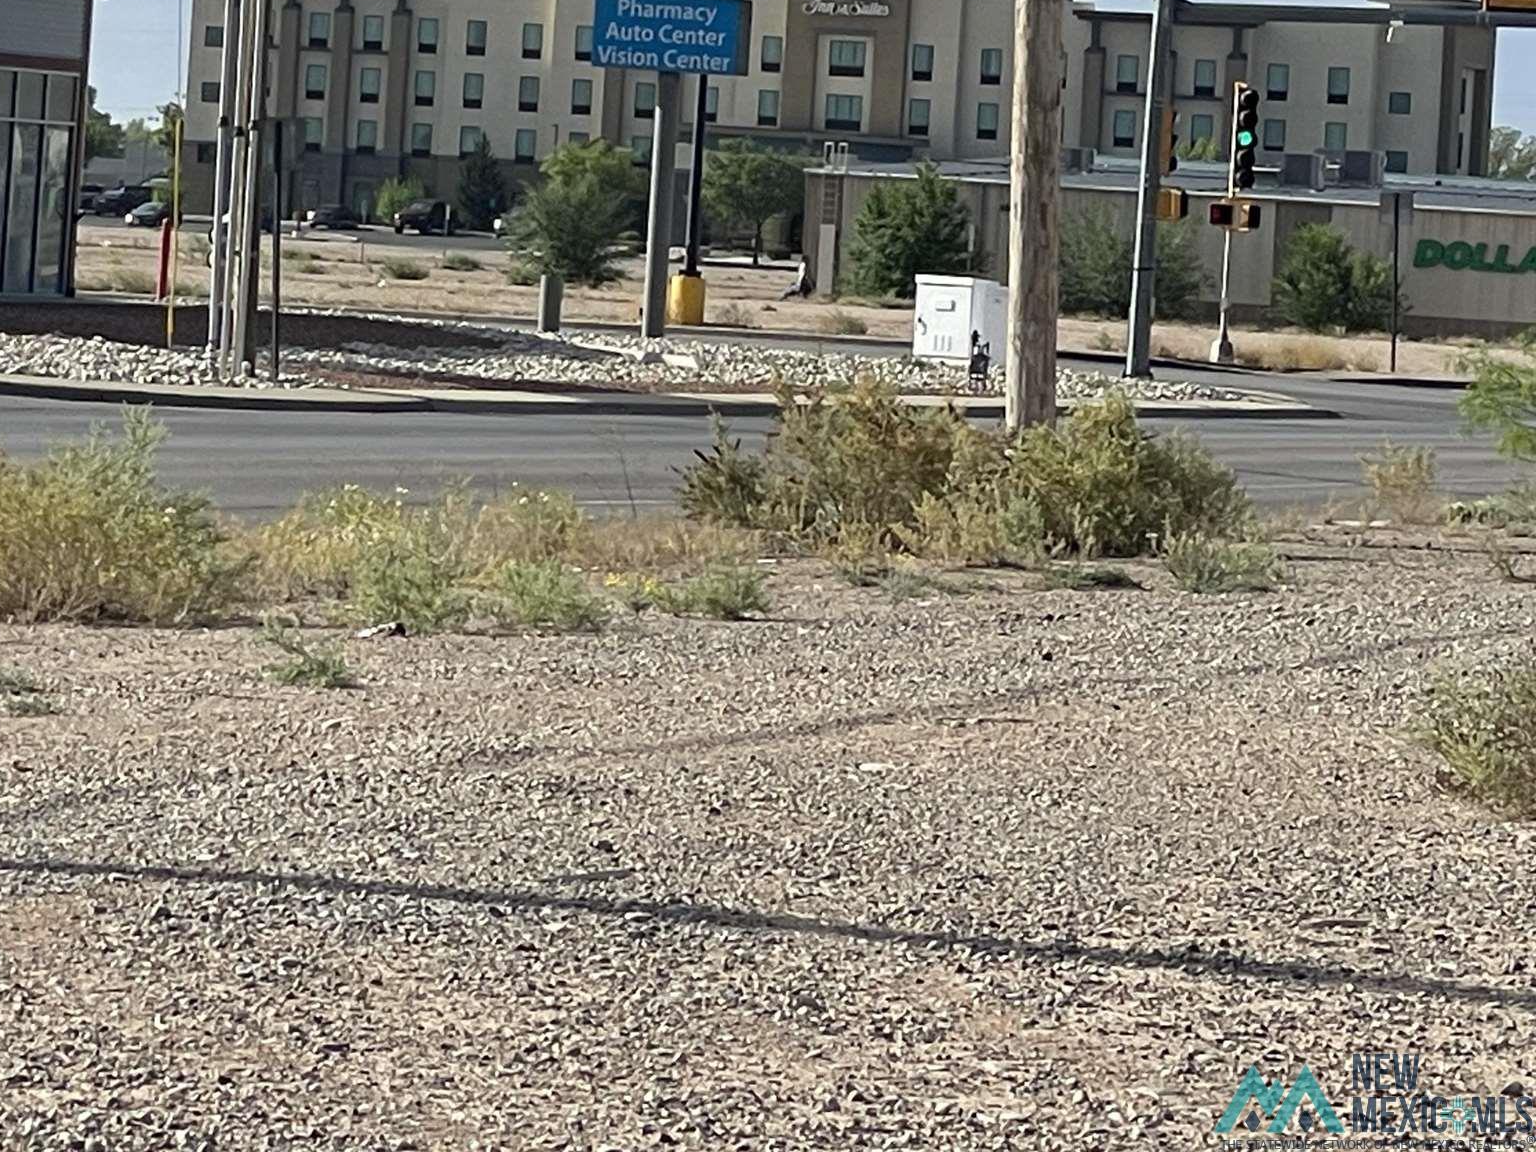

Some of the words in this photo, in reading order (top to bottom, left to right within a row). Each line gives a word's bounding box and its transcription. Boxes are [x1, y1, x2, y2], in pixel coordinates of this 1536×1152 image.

[606, 22, 654, 42] Auto
[658, 24, 726, 46] Center
[597, 45, 658, 67] Vision
[664, 49, 731, 72] Center
